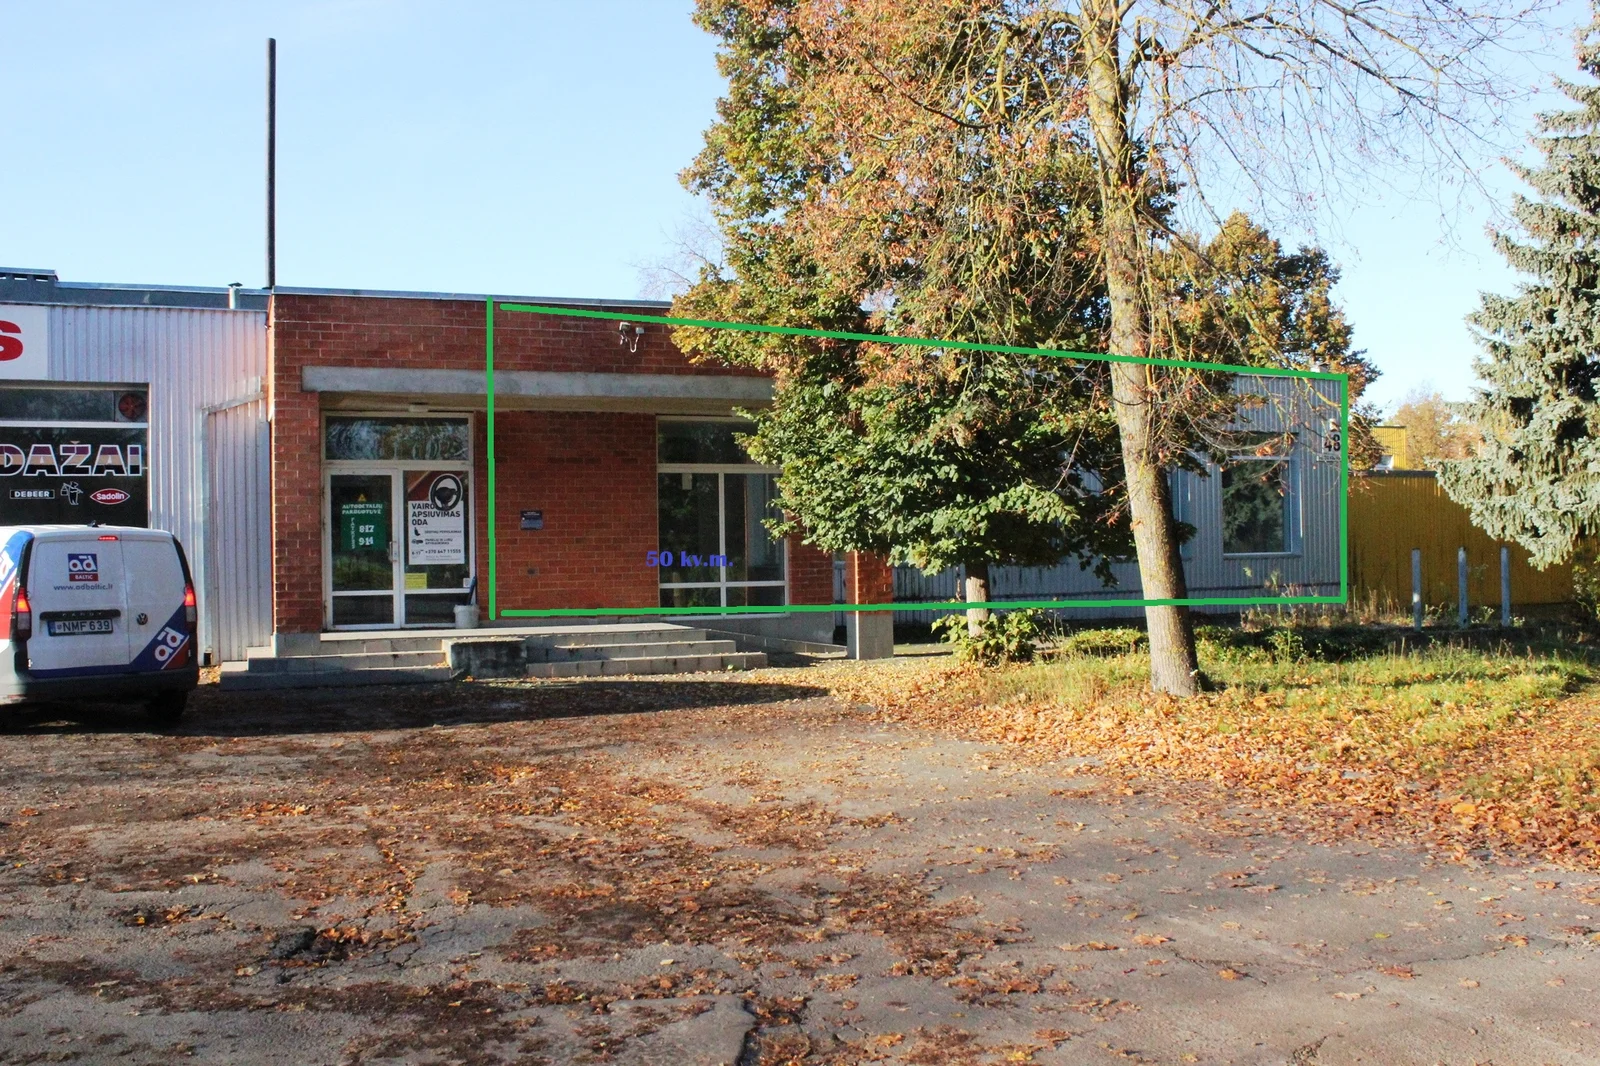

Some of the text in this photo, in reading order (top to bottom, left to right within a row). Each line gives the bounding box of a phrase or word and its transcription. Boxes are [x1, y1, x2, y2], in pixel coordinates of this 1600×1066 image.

[0, 441, 142, 476] DAŽAI
[14, 490, 50, 498] DEBEER
[96, 492, 125, 501] Sadolin
[53, 583, 113, 591] www.adbaltic.lt
[62, 620, 110, 632] NMF 639
